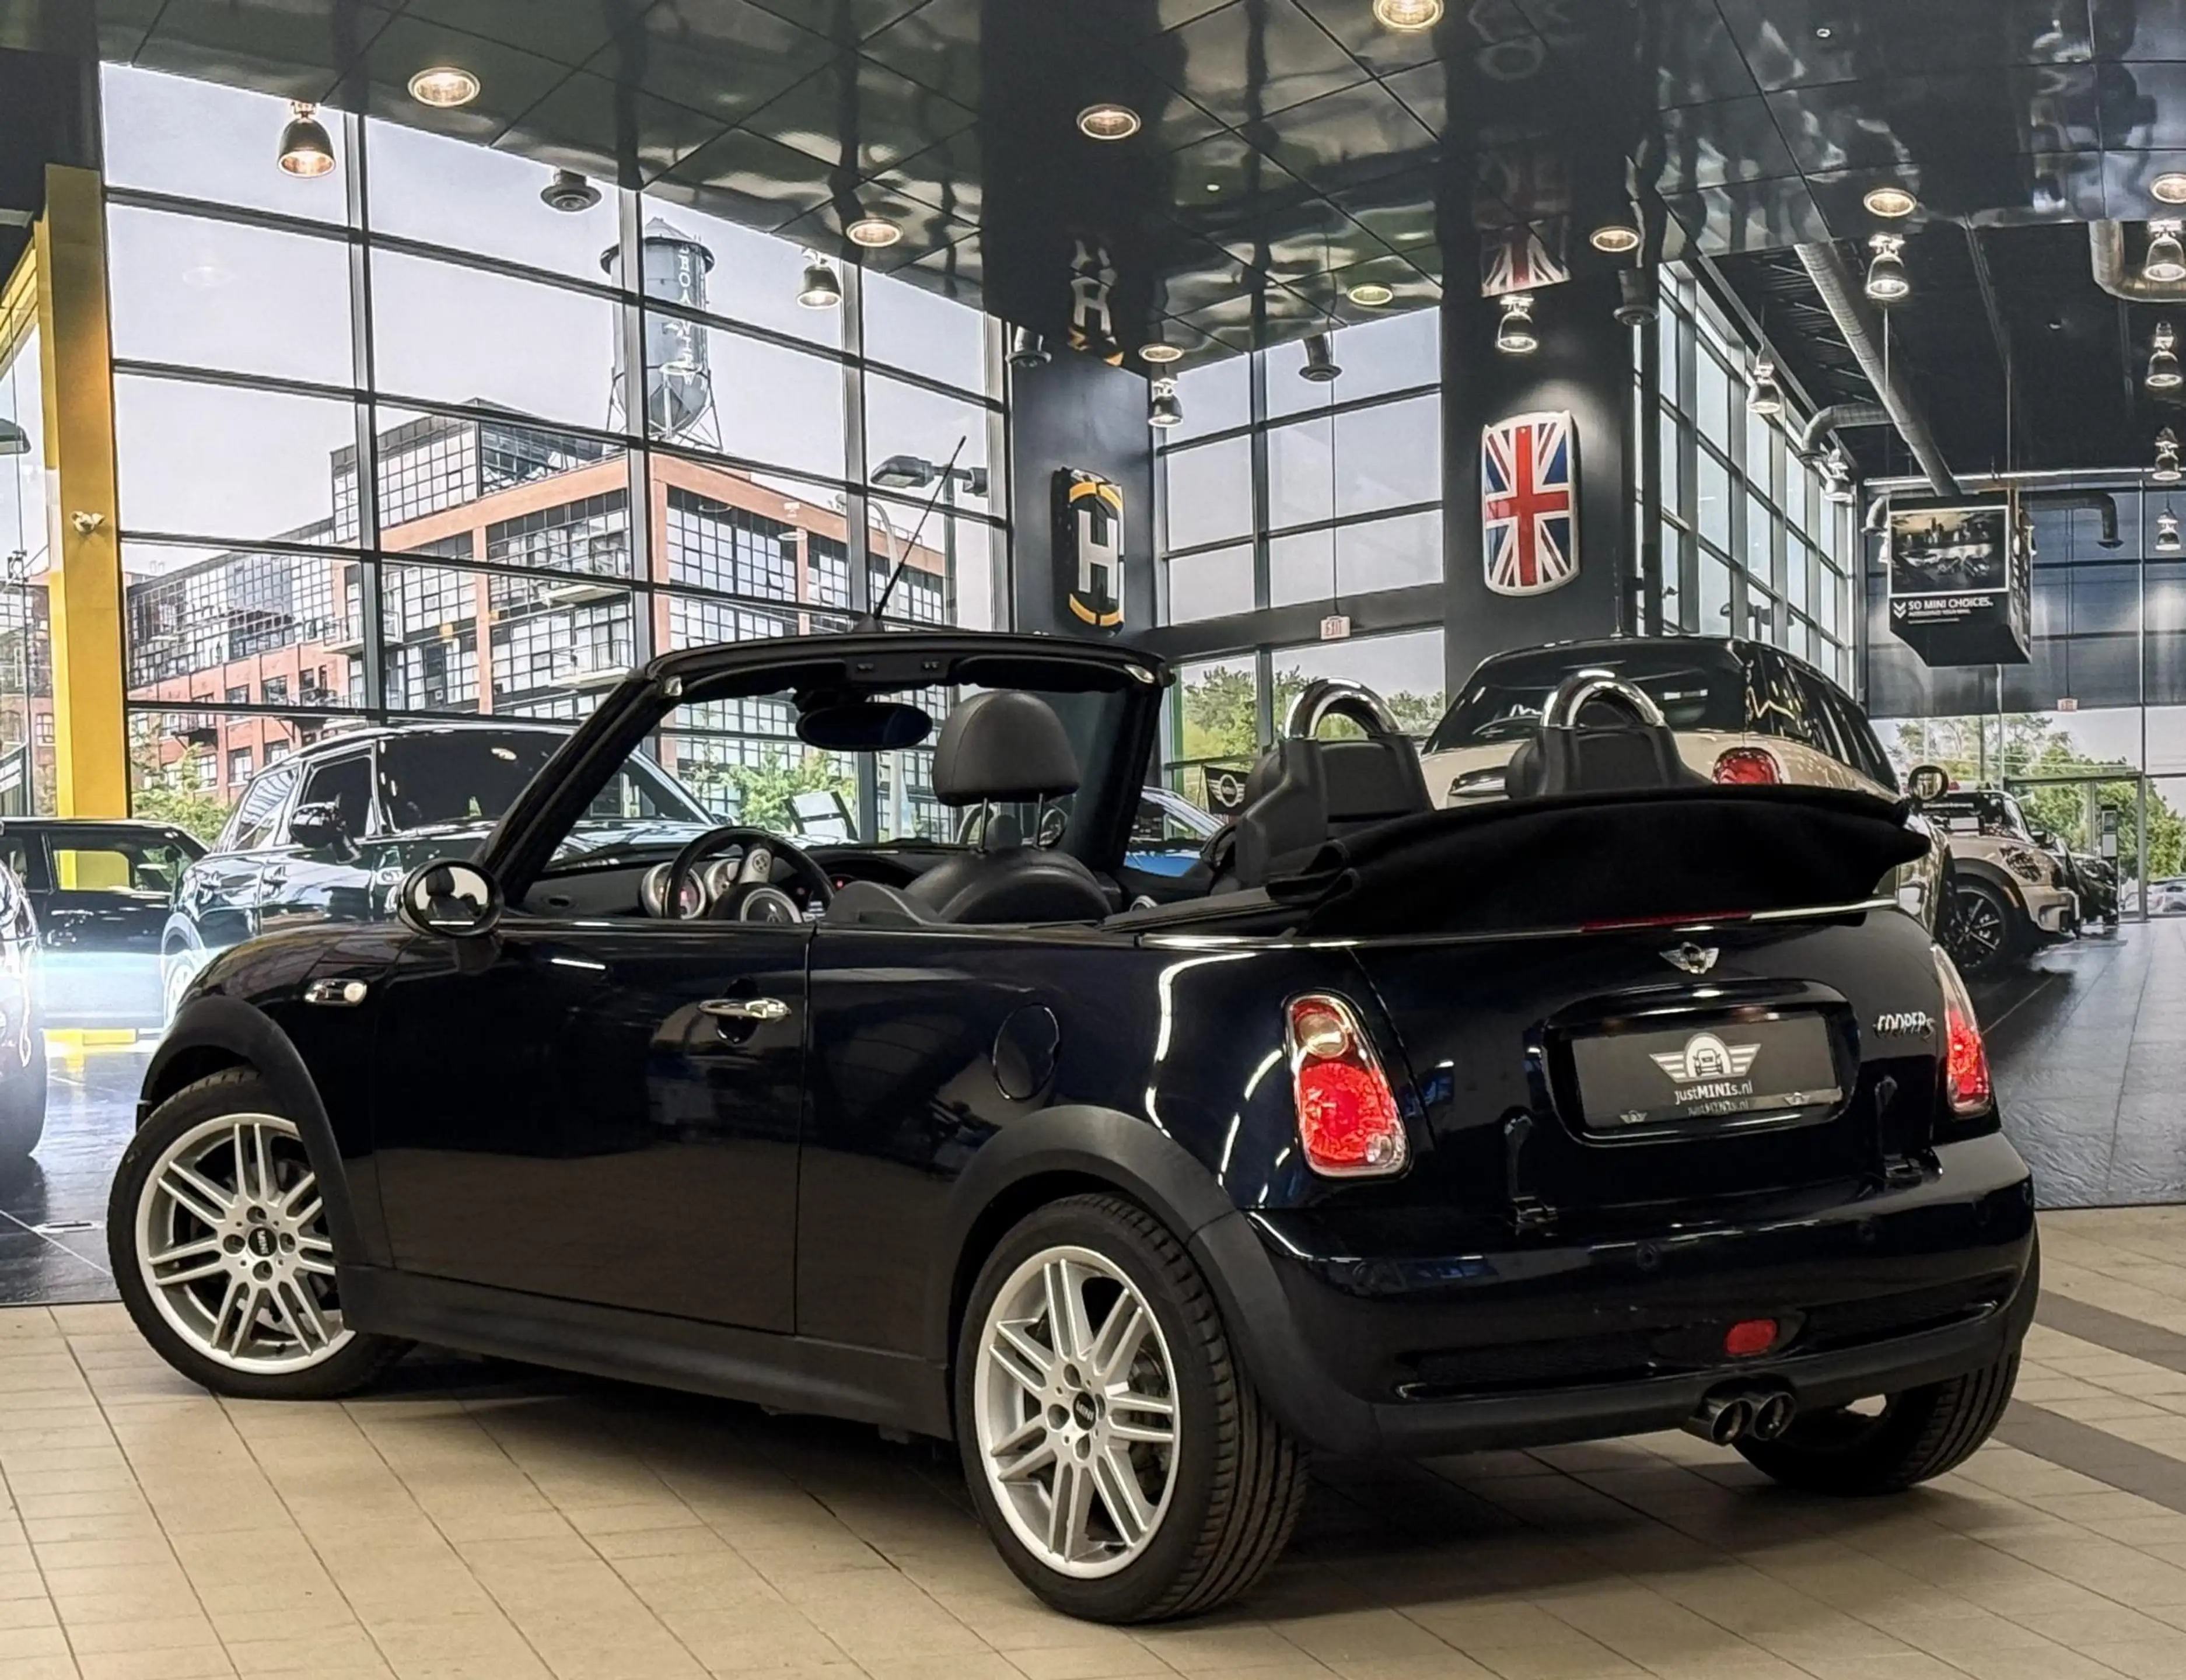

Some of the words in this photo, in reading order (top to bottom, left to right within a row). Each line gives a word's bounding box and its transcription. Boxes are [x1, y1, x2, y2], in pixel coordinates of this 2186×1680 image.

[1078, 509, 1118, 600] H
[1908, 600, 1922, 610] SO
[1923, 599, 1947, 610] MINI
